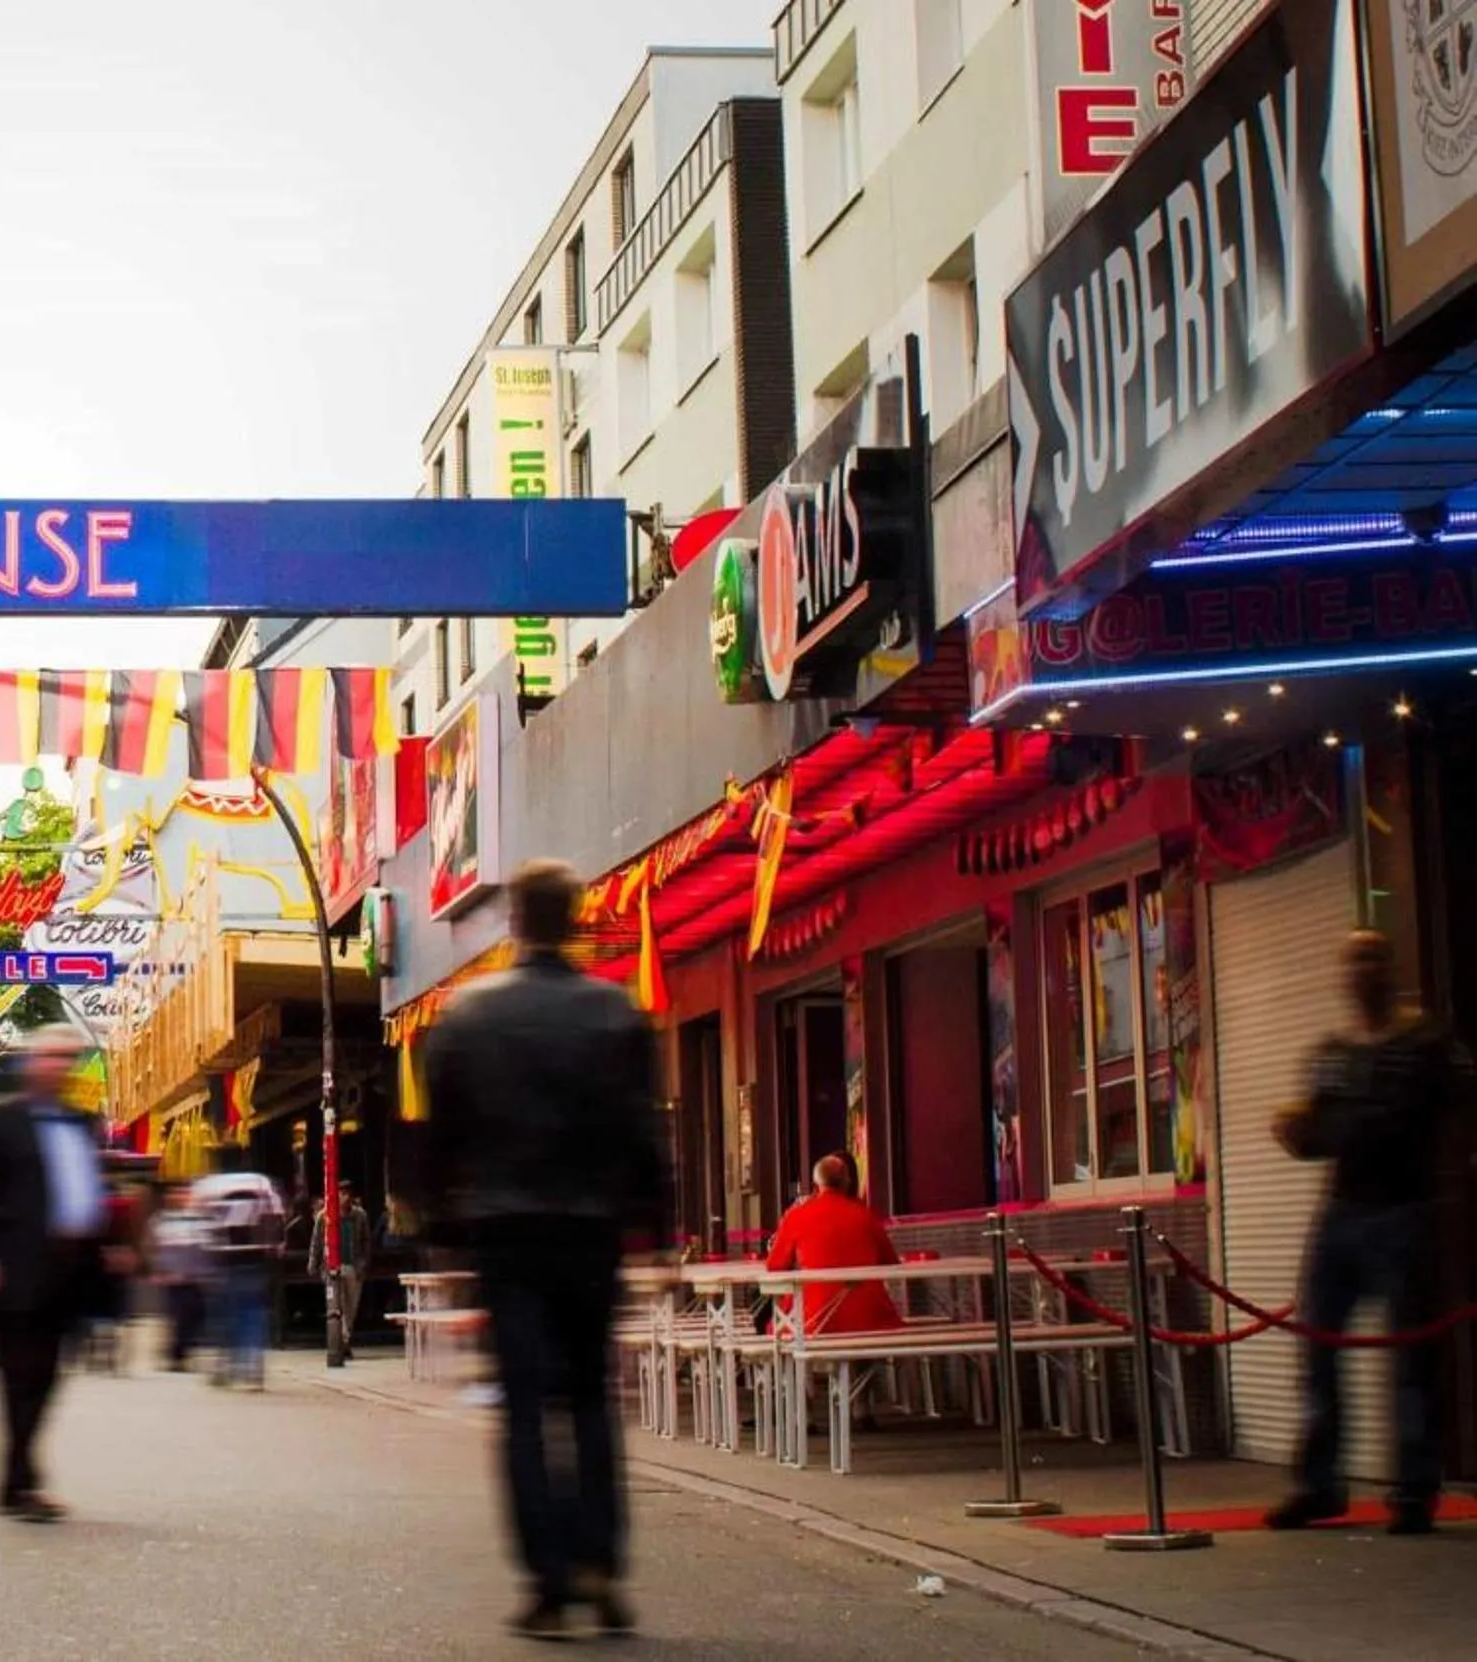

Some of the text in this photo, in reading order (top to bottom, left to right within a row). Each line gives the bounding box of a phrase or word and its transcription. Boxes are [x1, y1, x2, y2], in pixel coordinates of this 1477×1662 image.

[1047, 65, 1299, 528] SUPERFLY
[1035, 566, 1477, 666] G@LERIE-BA
[46, 907, 148, 945] Colibri
